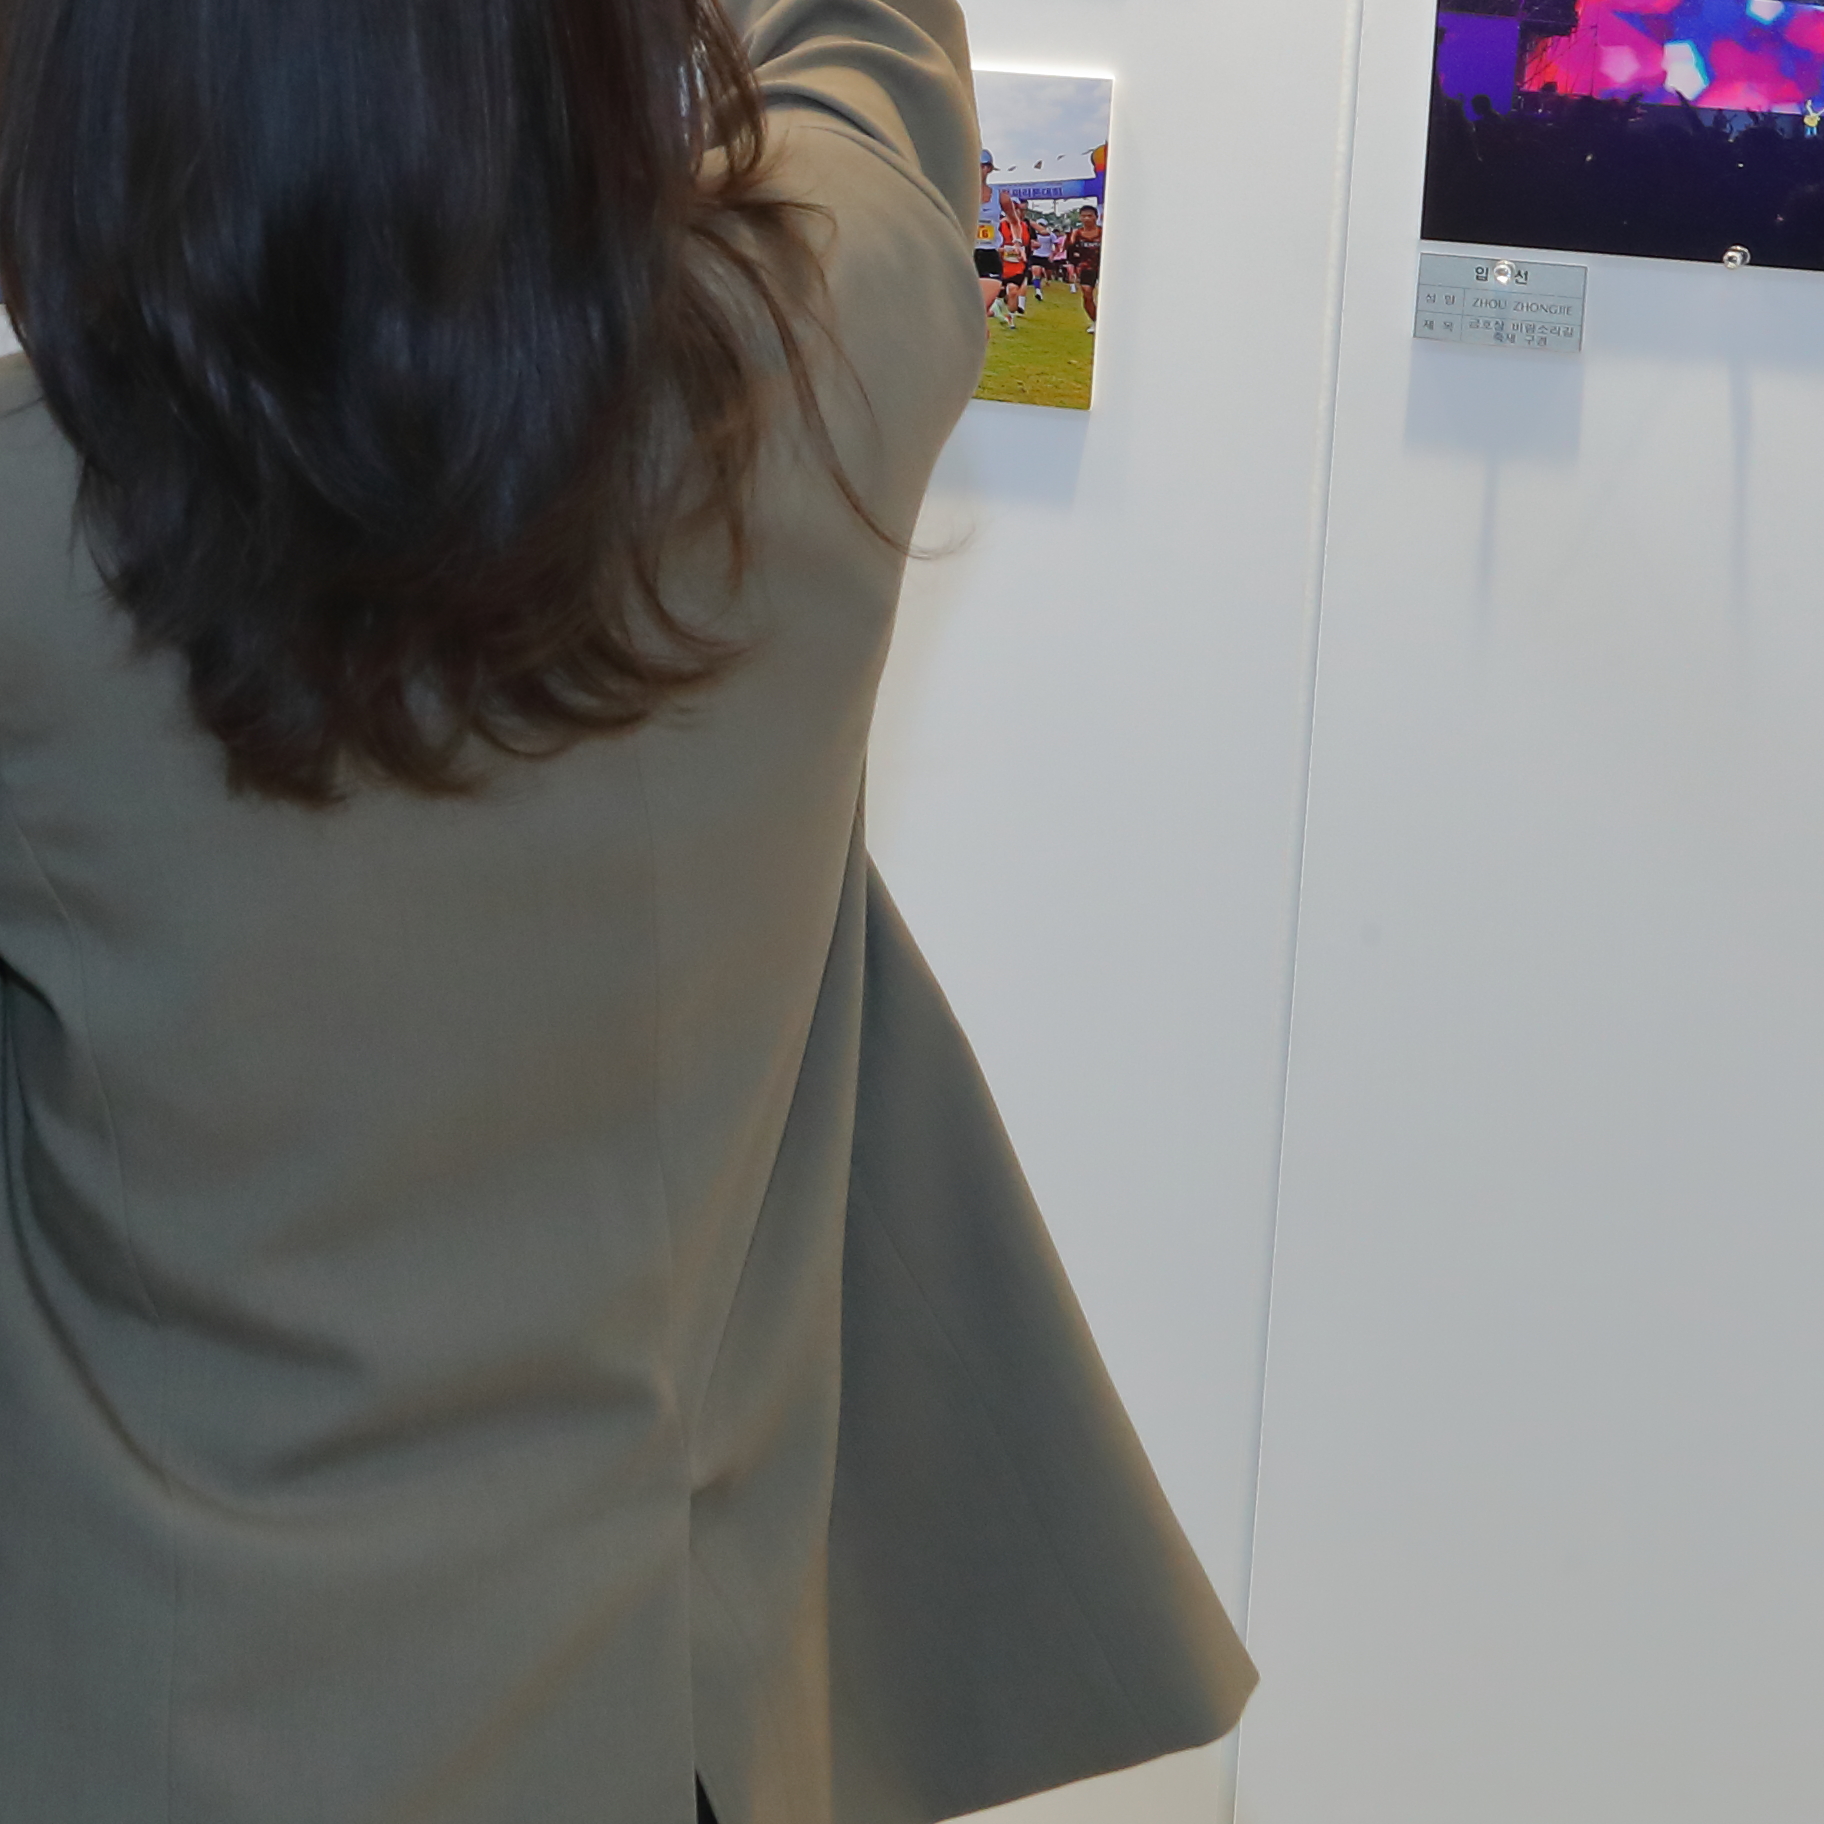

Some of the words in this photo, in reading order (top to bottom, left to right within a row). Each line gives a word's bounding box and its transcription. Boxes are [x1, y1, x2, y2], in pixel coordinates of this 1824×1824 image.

[1474, 265, 1489, 282] 입
[1514, 269, 1529, 286] 선
[1471, 297, 1508, 310] ZHOU
[1512, 301, 1573, 315] ZHONGJIE
